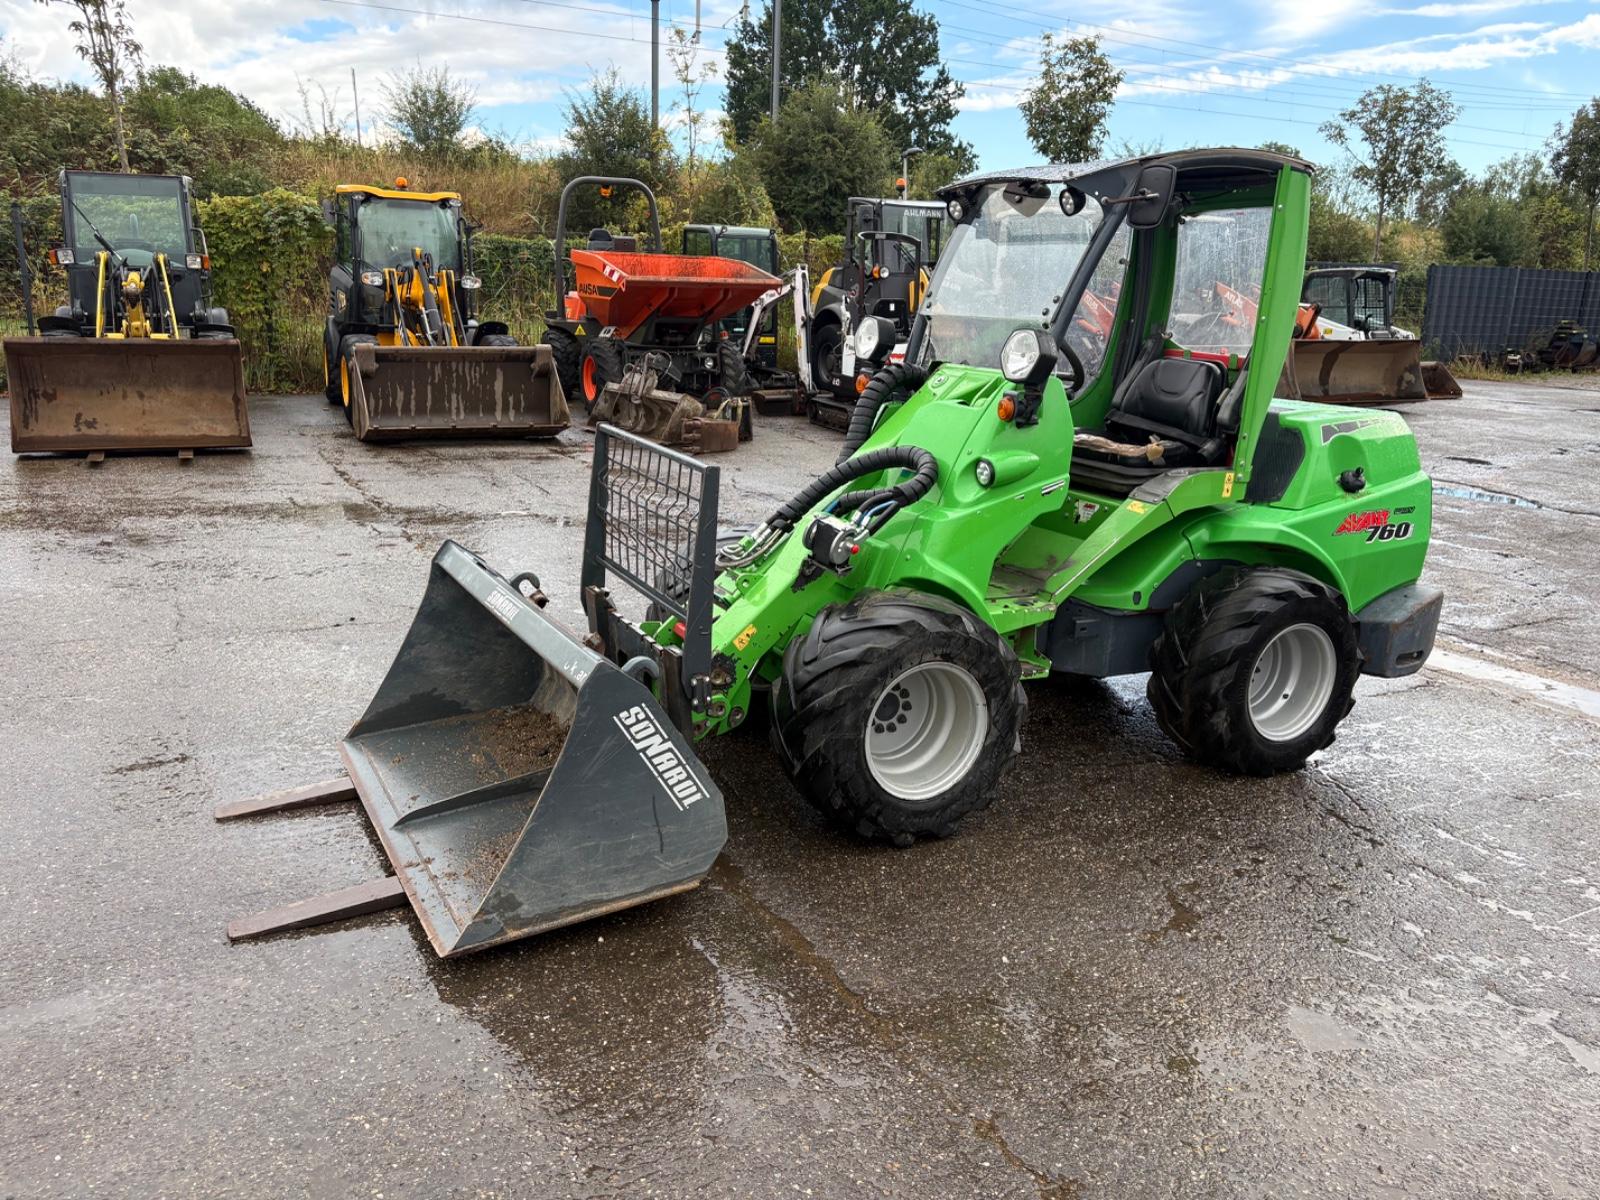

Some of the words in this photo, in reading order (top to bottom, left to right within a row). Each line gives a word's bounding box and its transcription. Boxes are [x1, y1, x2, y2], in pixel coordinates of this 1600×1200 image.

[903, 209, 941, 217] AHLMANN
[578, 283, 598, 296] AUSA
[1332, 508, 1390, 536] AVANT
[1365, 521, 1414, 545] 760
[618, 706, 703, 809] SONAROL
